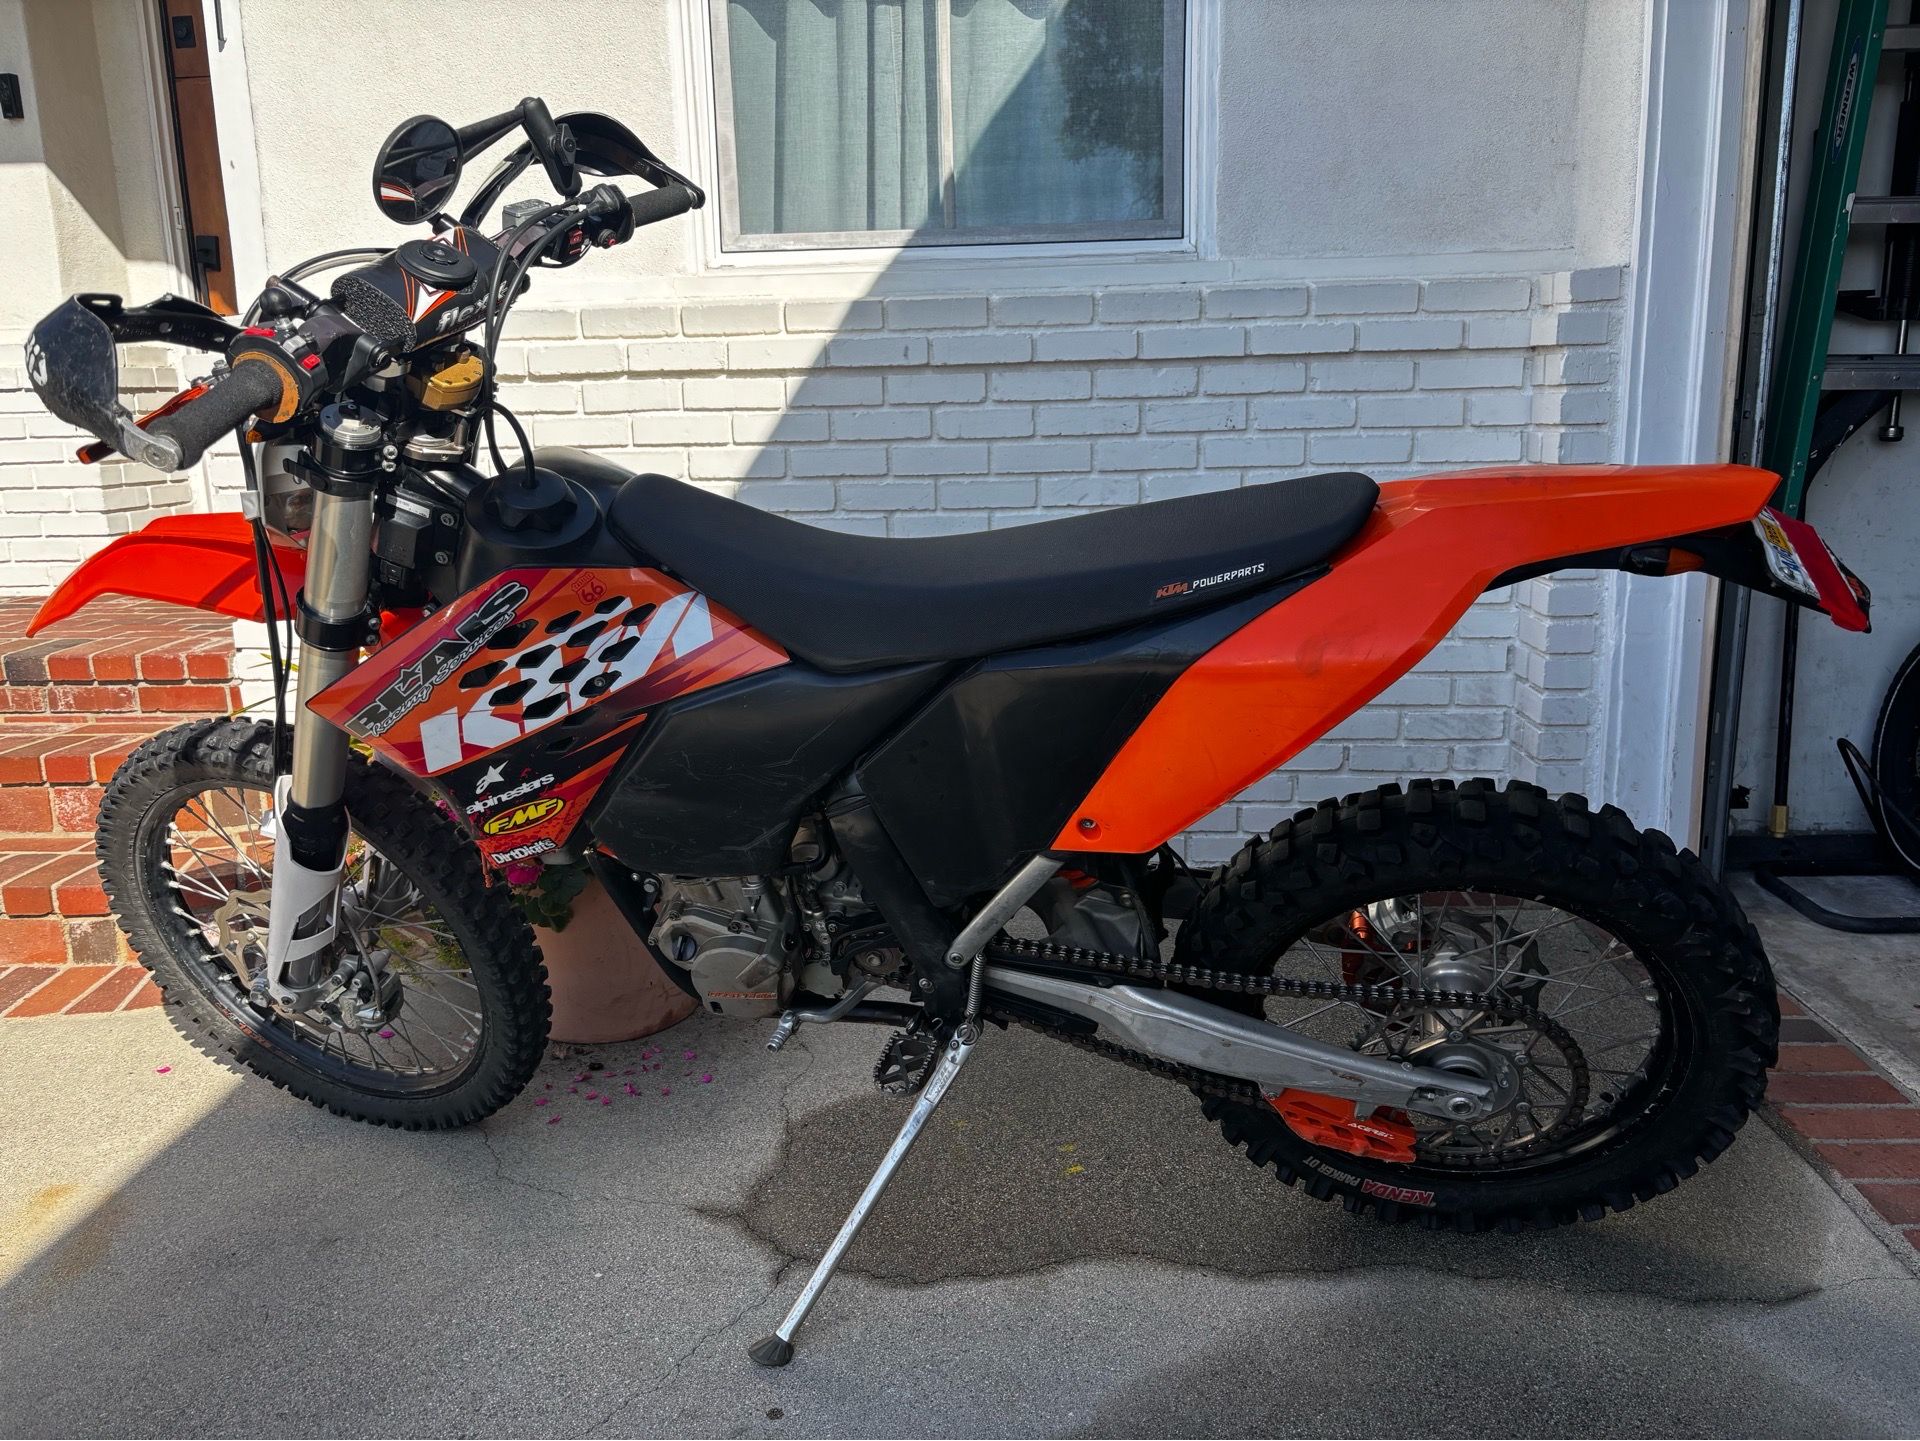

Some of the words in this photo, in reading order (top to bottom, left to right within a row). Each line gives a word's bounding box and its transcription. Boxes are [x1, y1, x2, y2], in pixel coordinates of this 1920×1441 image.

[1835, 60, 1856, 143] WERNER
[582, 581, 604, 602] 66
[1156, 582, 1189, 598] KTM
[1192, 563, 1266, 589] POWERPARTS
[371, 683, 433, 737] Racing
[433, 610, 516, 685] Services
[466, 773, 555, 815] alpinestars
[488, 798, 560, 835] FMF
[1303, 1155, 1323, 1169] DT
[1319, 1161, 1361, 1187] PARKER
[1361, 1178, 1435, 1206] KENDA
